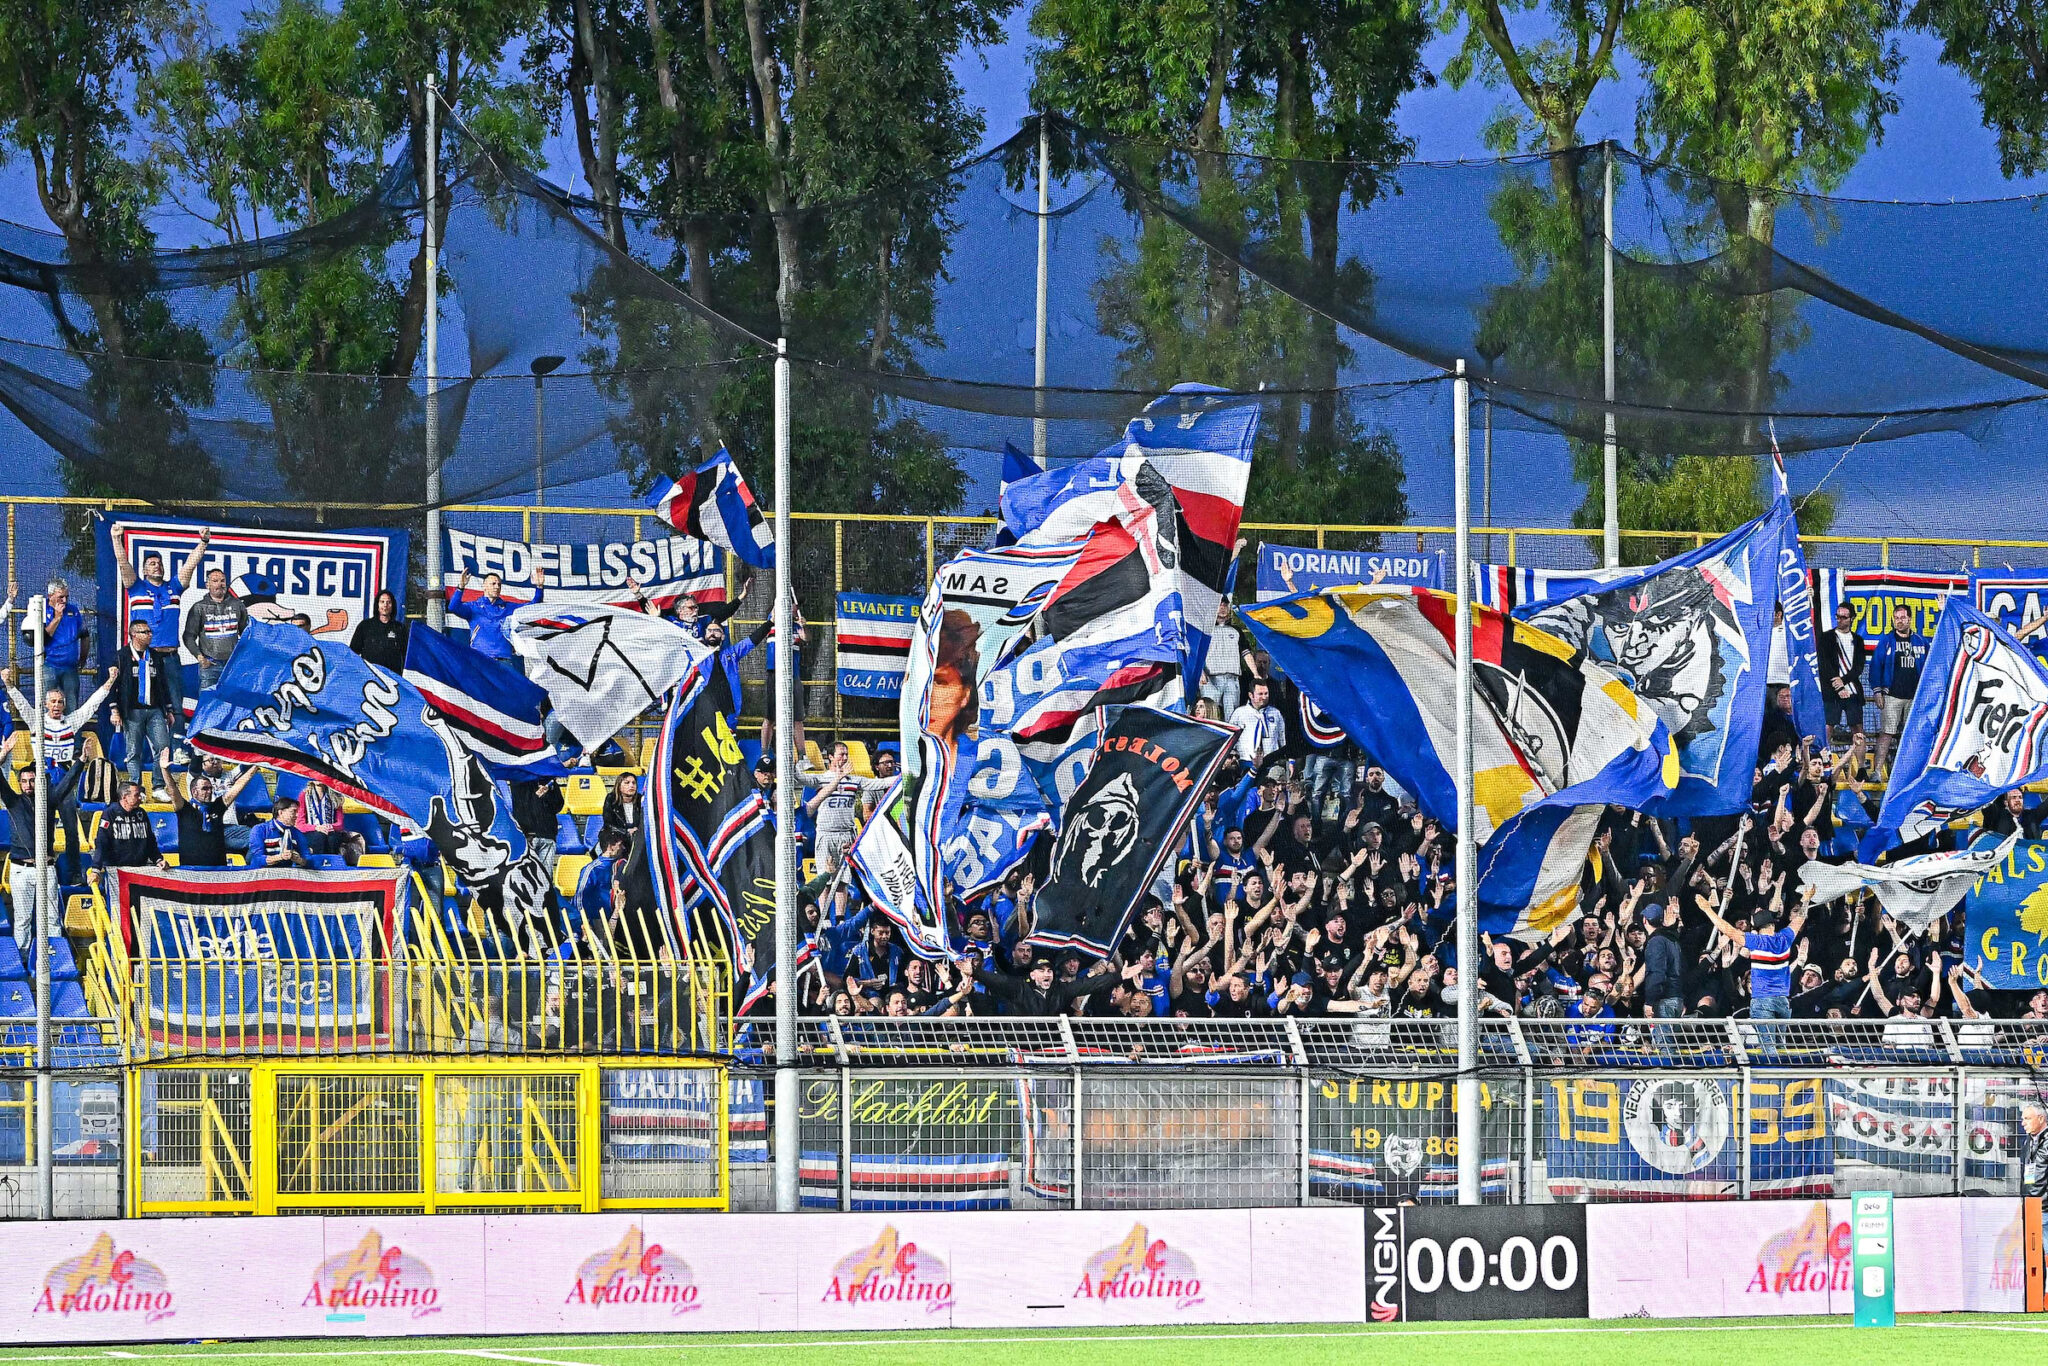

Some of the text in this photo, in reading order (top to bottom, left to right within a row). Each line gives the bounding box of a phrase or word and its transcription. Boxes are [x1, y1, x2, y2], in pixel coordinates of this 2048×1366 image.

[449, 529, 714, 588] FEDELISSIMI
[1273, 551, 1429, 578] DORIANI SARDI
[843, 600, 904, 618] LEVANTE
[844, 674, 872, 689] Club
[799, 1079, 998, 1125] Blacklist
[1552, 1079, 1619, 1145] 19
[1351, 1127, 1459, 1157] 19 86
[1371, 1207, 1398, 1307] NGM
[1407, 1235, 1580, 1293] 00:00
[565, 1277, 699, 1304] Ardolino
[821, 1275, 952, 1303] Ardolino
[1073, 1272, 1201, 1299] Ardolino
[1745, 1263, 1852, 1293] Ardoli
[33, 1284, 173, 1312] Ardolino
[301, 1280, 439, 1308] Ardolino
